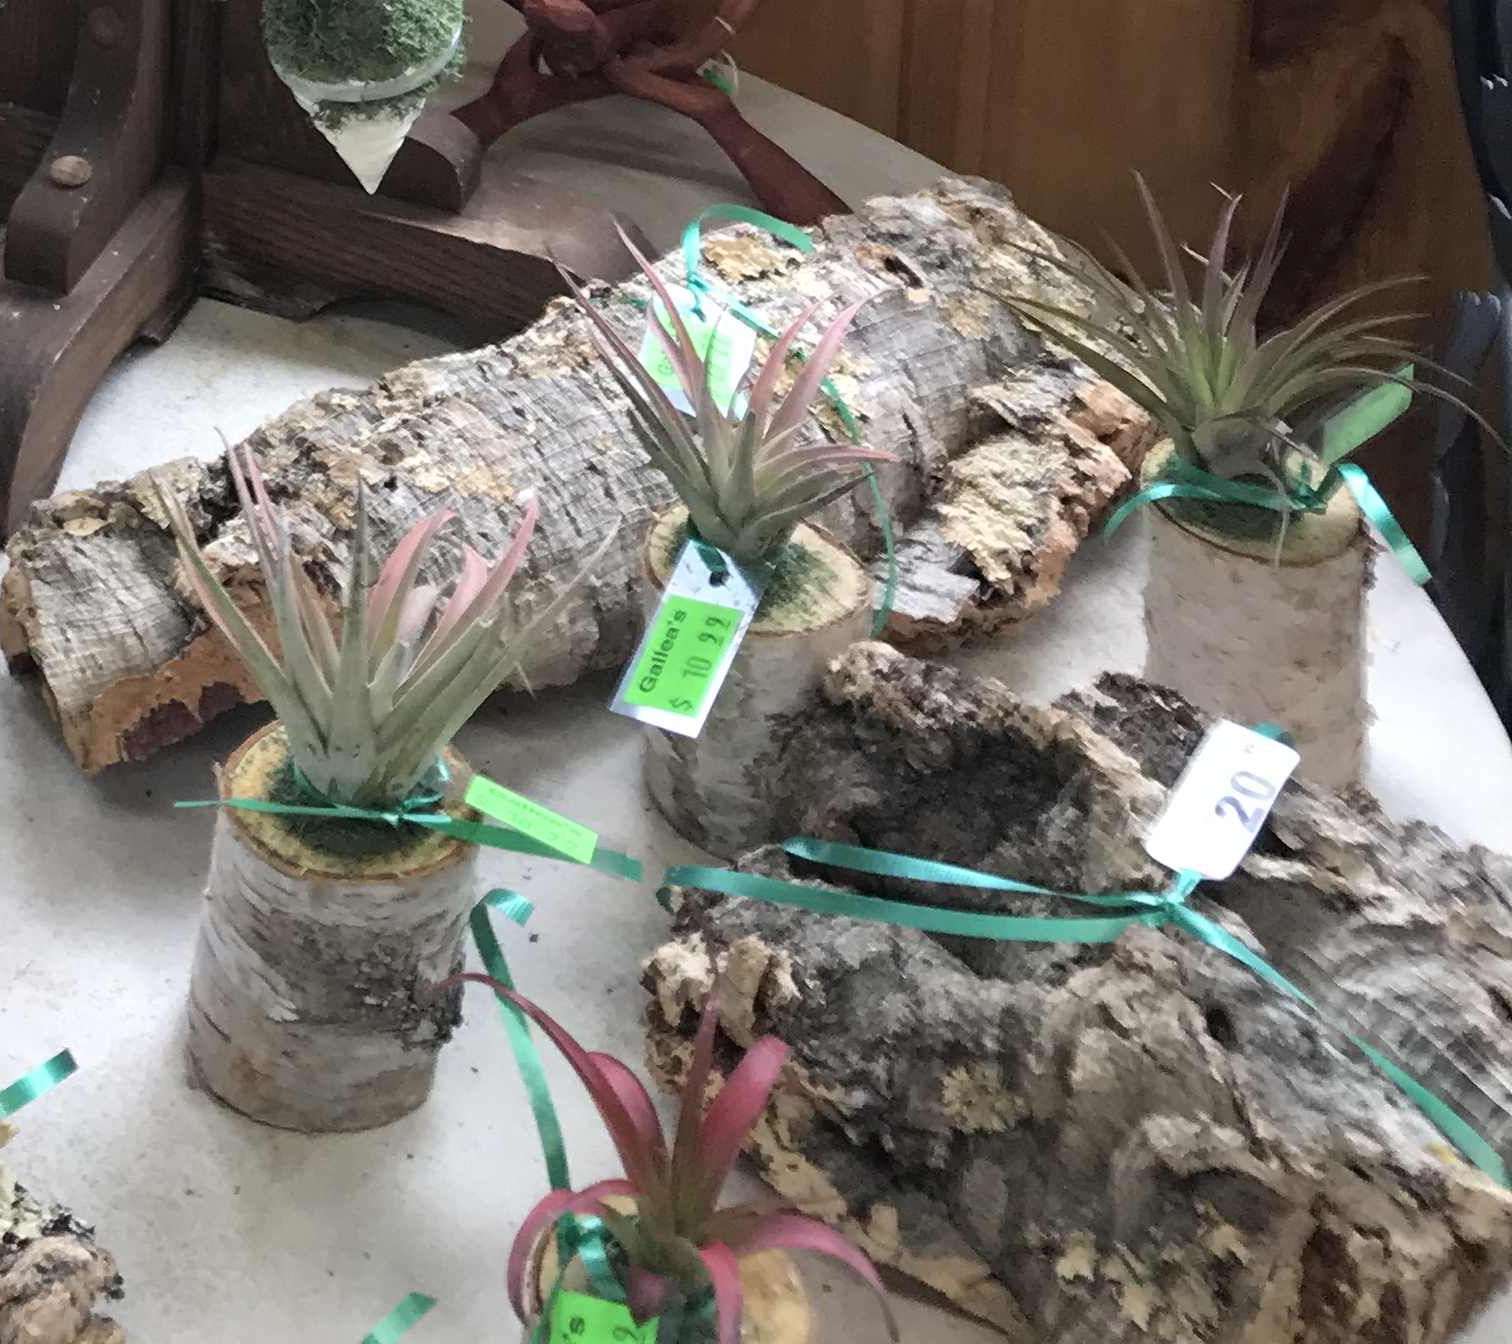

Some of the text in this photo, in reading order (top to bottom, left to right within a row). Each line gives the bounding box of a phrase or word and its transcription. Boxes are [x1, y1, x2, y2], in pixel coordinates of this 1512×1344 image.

[639, 609, 687, 693] Gallea's
[669, 616, 731, 711] $ 10 99
[1214, 771, 1276, 833] 20
